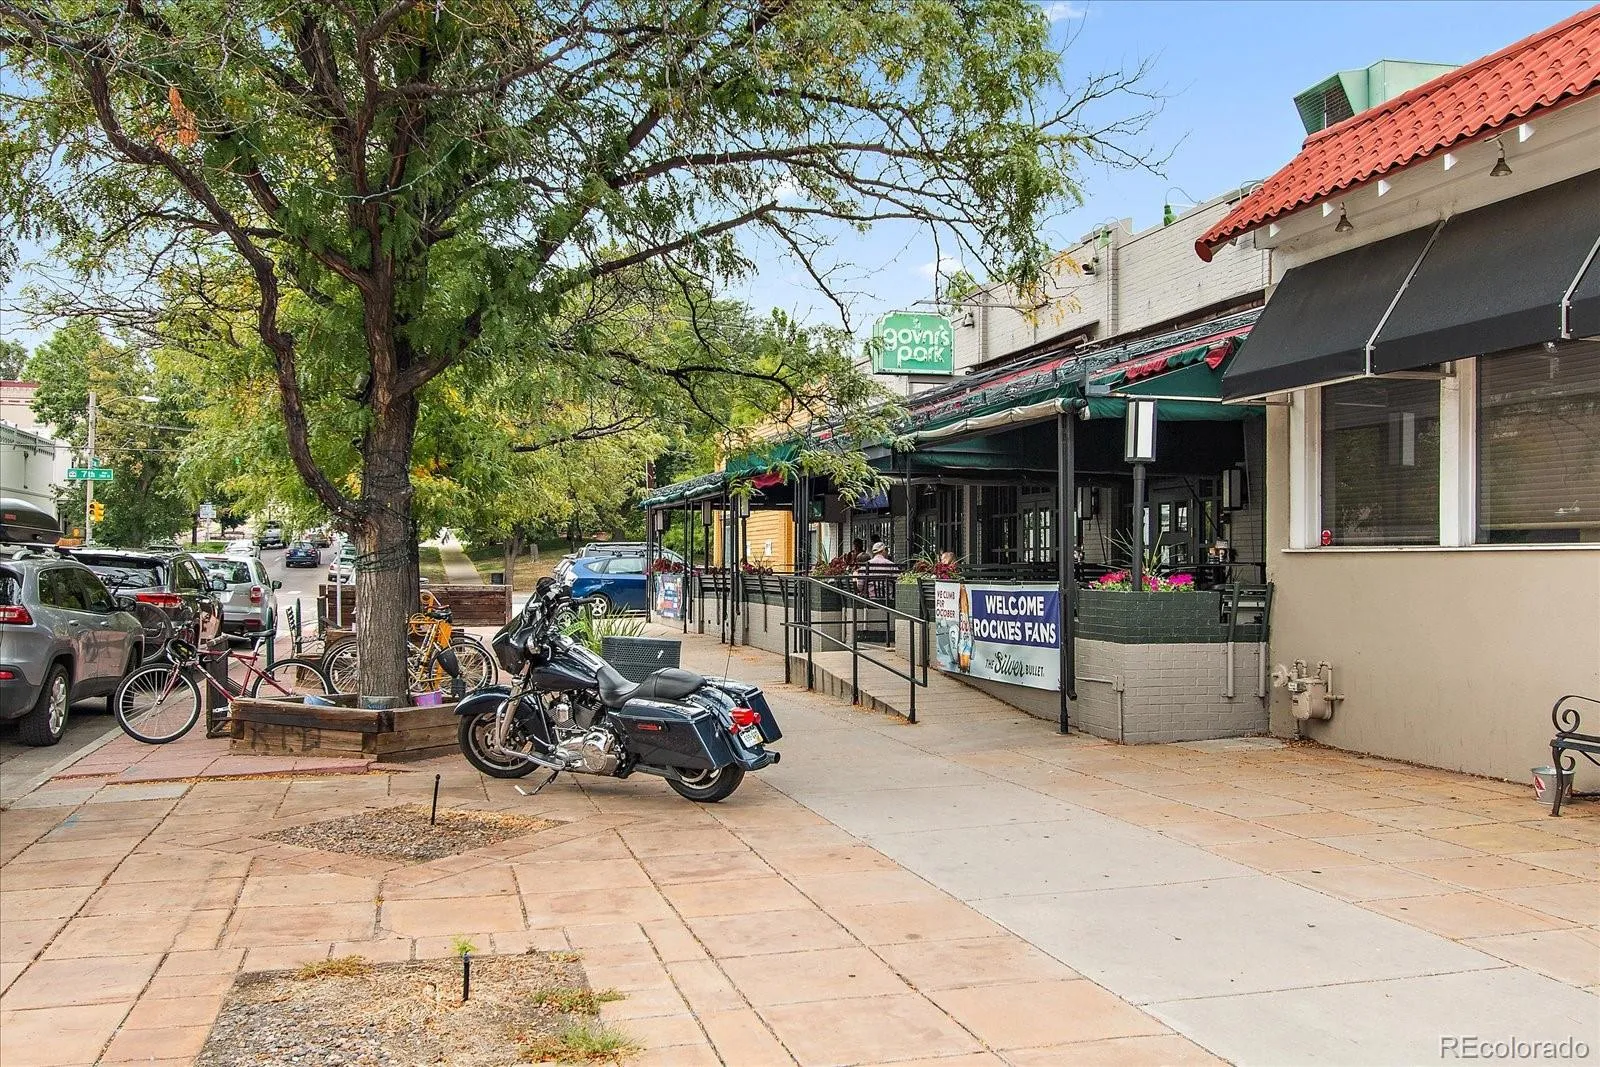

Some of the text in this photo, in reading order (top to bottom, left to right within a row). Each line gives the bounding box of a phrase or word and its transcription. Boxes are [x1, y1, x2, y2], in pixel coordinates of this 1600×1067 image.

[883, 325, 949, 351] govnr's
[897, 345, 945, 368] park
[80, 470, 96, 478] 7th
[985, 594, 1045, 616] WELCOME
[973, 618, 1022, 641] ROCKIES
[1024, 621, 1057, 644] FANS
[984, 659, 995, 670] THE
[994, 651, 1025, 677] Silver
